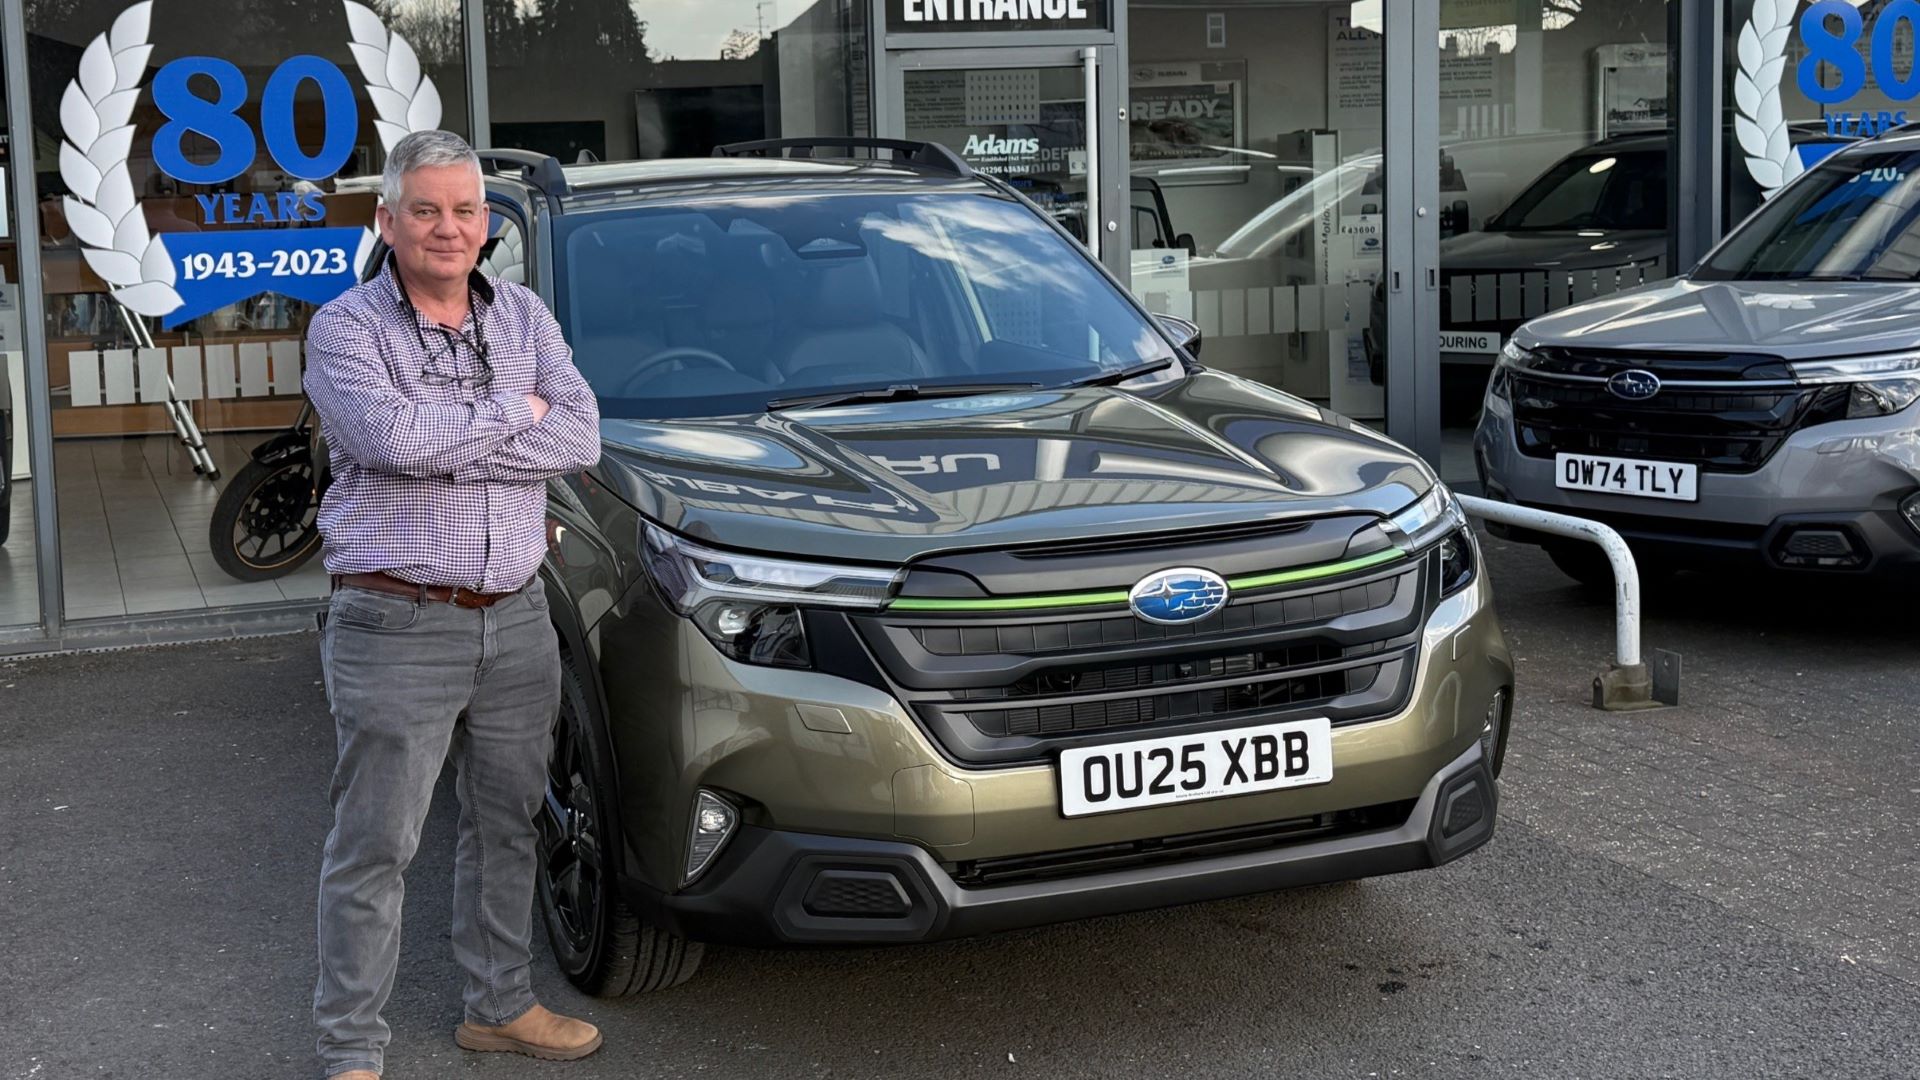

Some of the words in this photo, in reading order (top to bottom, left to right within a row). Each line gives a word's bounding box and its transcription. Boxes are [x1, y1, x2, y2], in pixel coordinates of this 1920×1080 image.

[1797, 0, 1920, 104] 80
[152, 55, 359, 184] 80
[1131, 99, 1219, 120] READY
[1824, 111, 1907, 136] YEARS
[962, 134, 1039, 155] Adams
[194, 191, 327, 224] YEARS
[181, 248, 348, 281] 1943-2023
[1565, 458, 1627, 489] OW74
[1635, 465, 1683, 494] TLY
[1082, 742, 1206, 803] OU25
[1221, 730, 1310, 786] XBB
